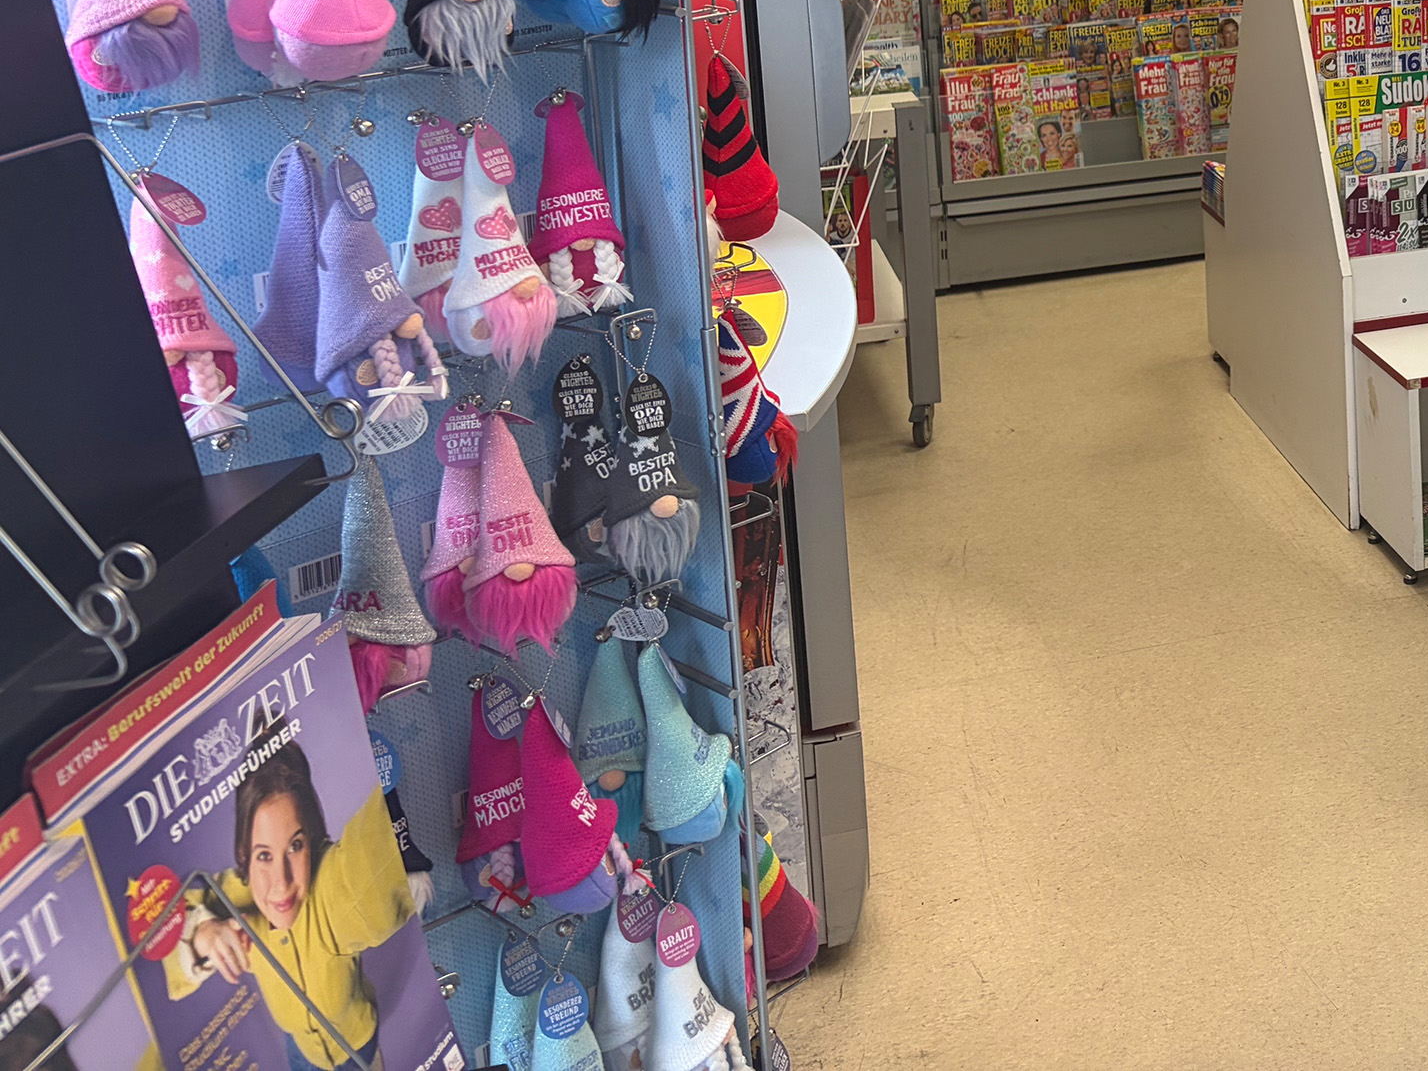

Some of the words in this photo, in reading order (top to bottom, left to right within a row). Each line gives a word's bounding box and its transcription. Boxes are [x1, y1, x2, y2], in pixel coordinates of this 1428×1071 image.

[1139, 66, 1165, 79] Mehr
[1398, 52, 1421, 71] 16
[1358, 99, 1370, 107] 128
[350, 187, 371, 203] OMA
[541, 189, 604, 211] BESONDERE
[539, 202, 611, 230] SCHWESTER
[634, 406, 664, 419] OPA
[446, 436, 480, 447] OMI
[629, 452, 676, 476] BESTER
[638, 471, 677, 492] OPA
[487, 511, 533, 534] BESTE
[492, 532, 534, 553] OMI
[56, 734, 108, 787] EXTRA:
[108, 665, 192, 742] Berufswelt
[194, 647, 216, 673] der
[216, 602, 265, 659] Zukunft
[587, 718, 635, 741] JEMAND
[124, 755, 196, 844] DIE
[238, 653, 315, 746] ZEIT
[169, 718, 302, 843] STUDIENFÜHRER
[473, 777, 524, 807] BESONDE
[475, 794, 526, 829] MÄDC
[622, 899, 654, 932] BRAUT
[659, 924, 695, 951] BRAUT
[542, 996, 583, 1018] BESONDERER
[550, 1007, 580, 1024] FREUND
